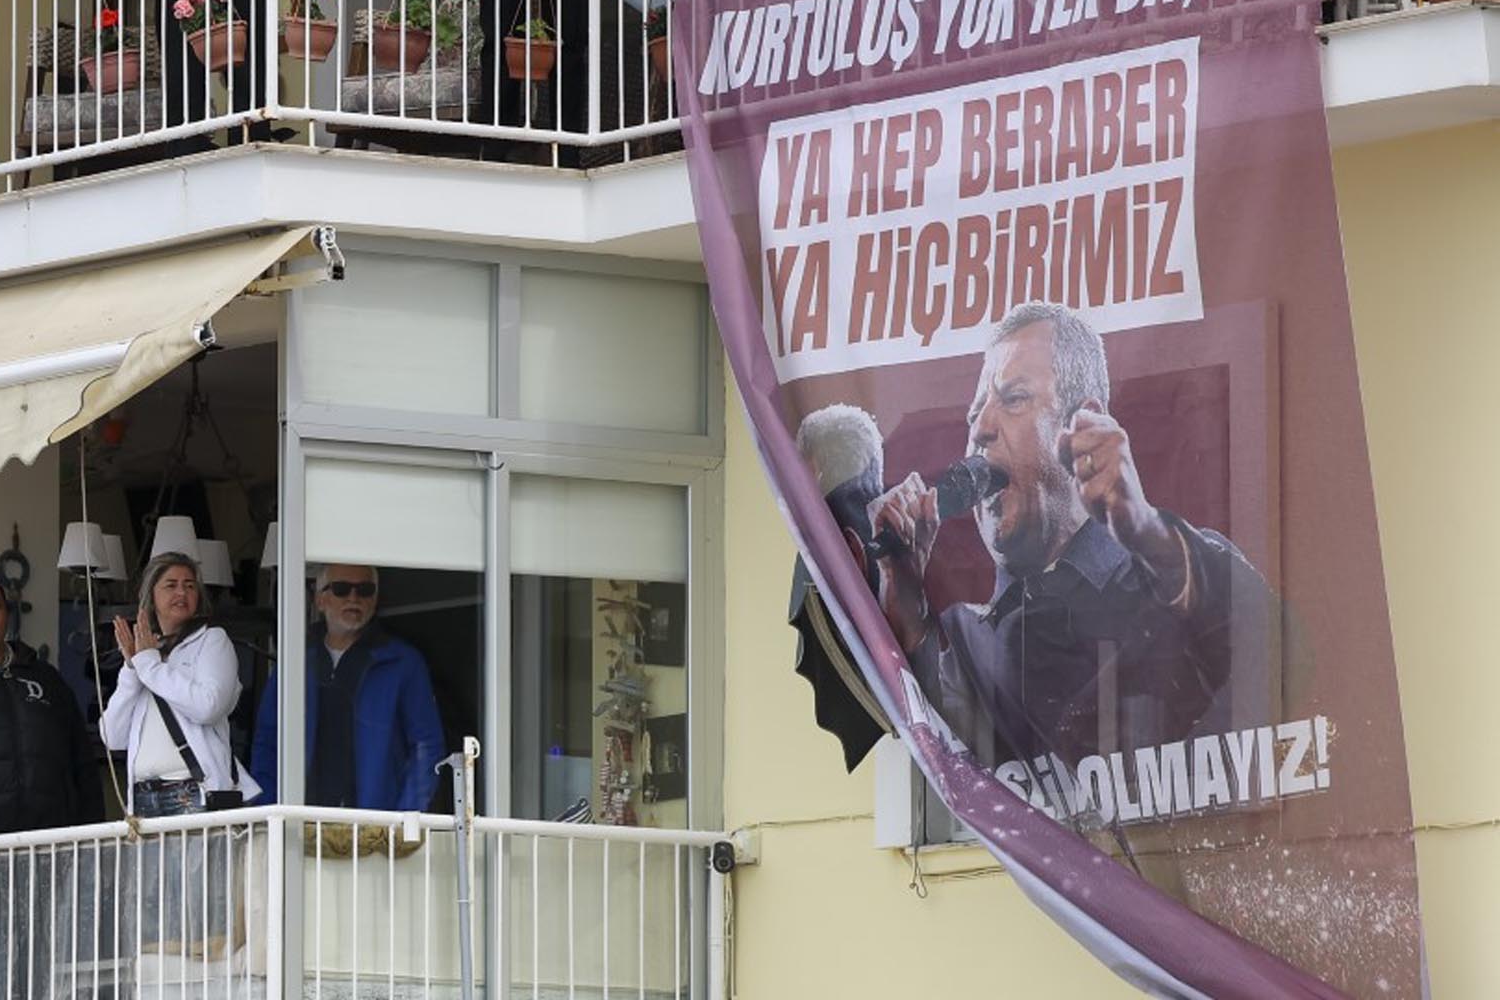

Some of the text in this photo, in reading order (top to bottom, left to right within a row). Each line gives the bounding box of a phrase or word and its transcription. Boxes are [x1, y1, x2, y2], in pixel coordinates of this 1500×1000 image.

[773, 58, 1188, 230] YA HEP BERABER
[766, 176, 1184, 357] YA HİÇBİRİMİZ
[1076, 714, 1332, 824] OLMAYIZ!
